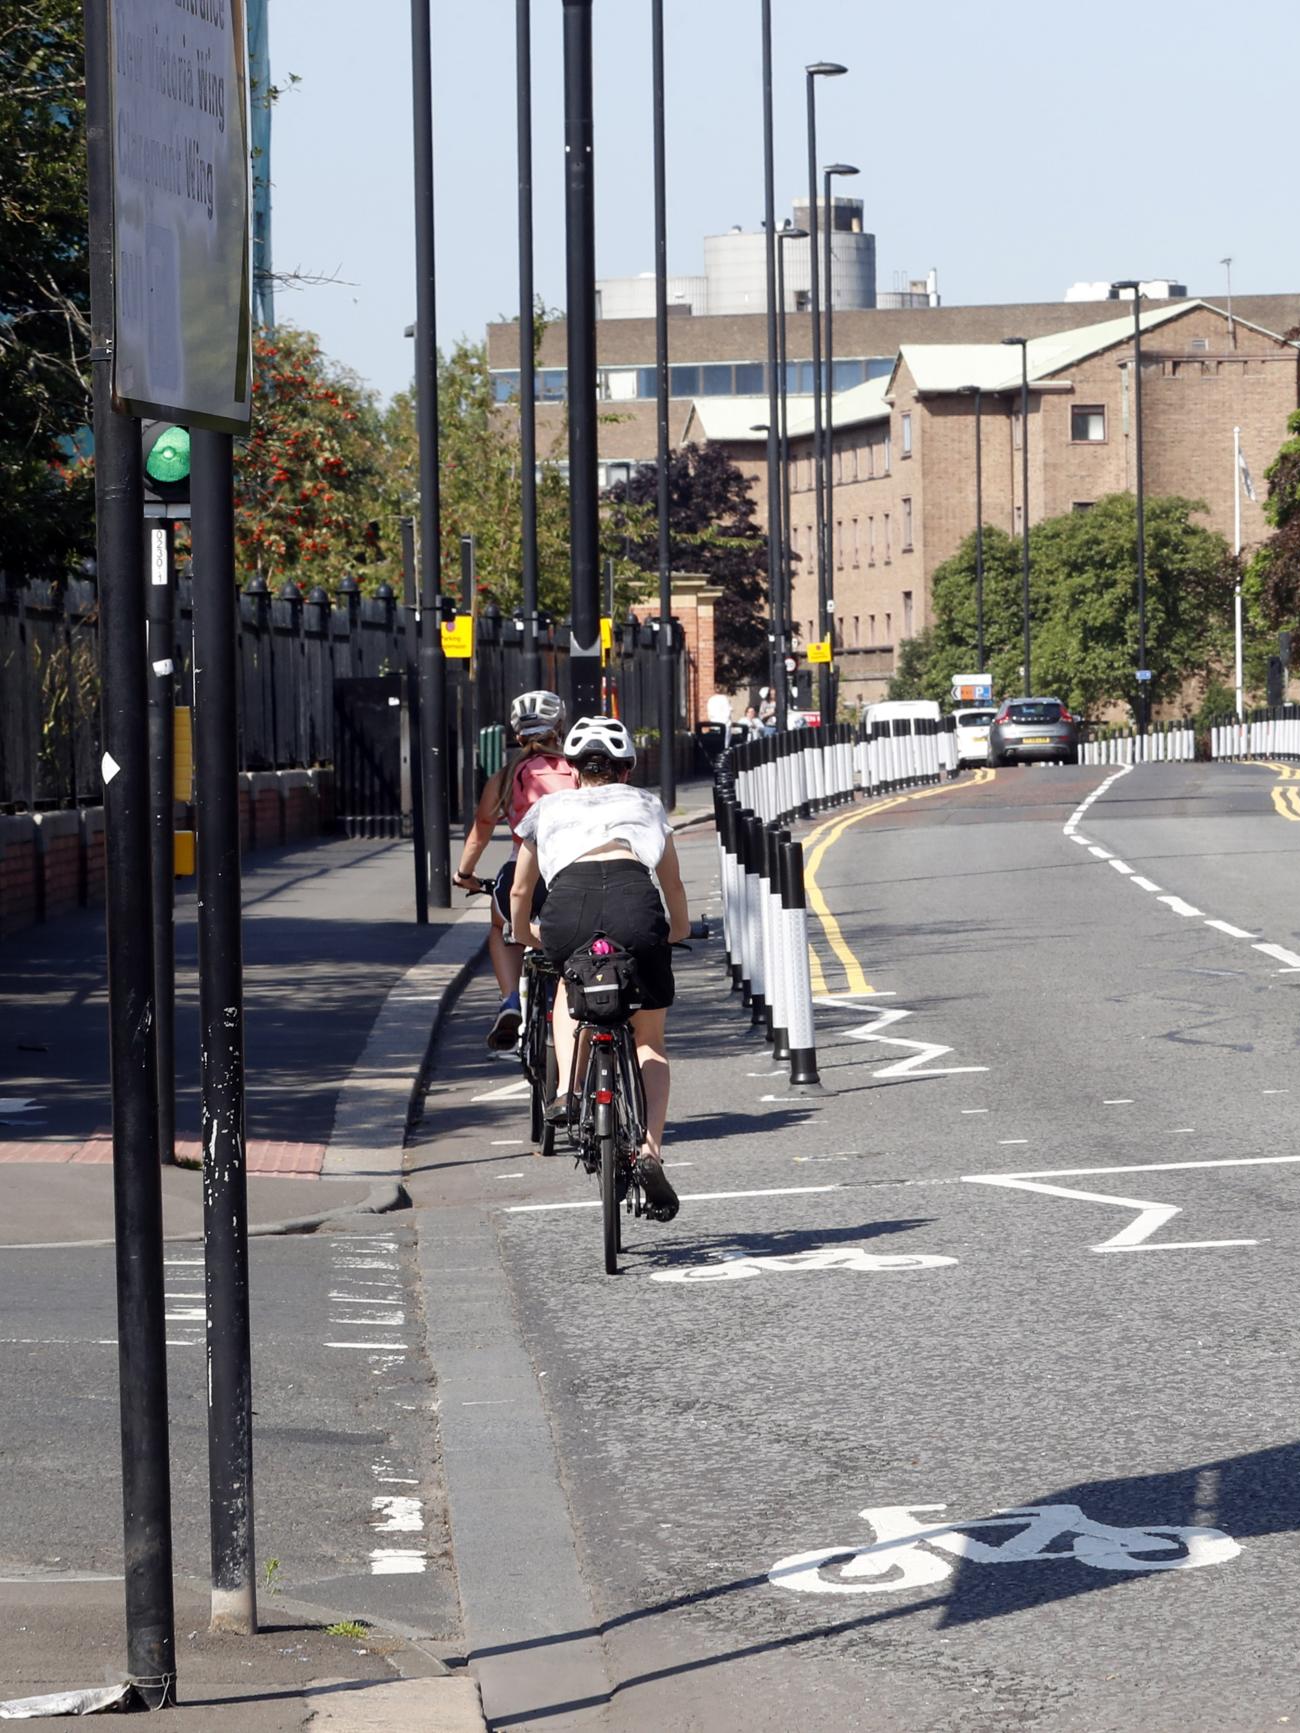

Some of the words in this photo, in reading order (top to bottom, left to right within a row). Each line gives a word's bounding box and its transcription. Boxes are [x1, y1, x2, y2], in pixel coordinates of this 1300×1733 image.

[116, 8, 144, 81] New
[149, 23, 194, 107] Victoria
[196, 48, 225, 133] Wing
[118, 107, 182, 196] Claremont
[184, 135, 214, 220] Wing
